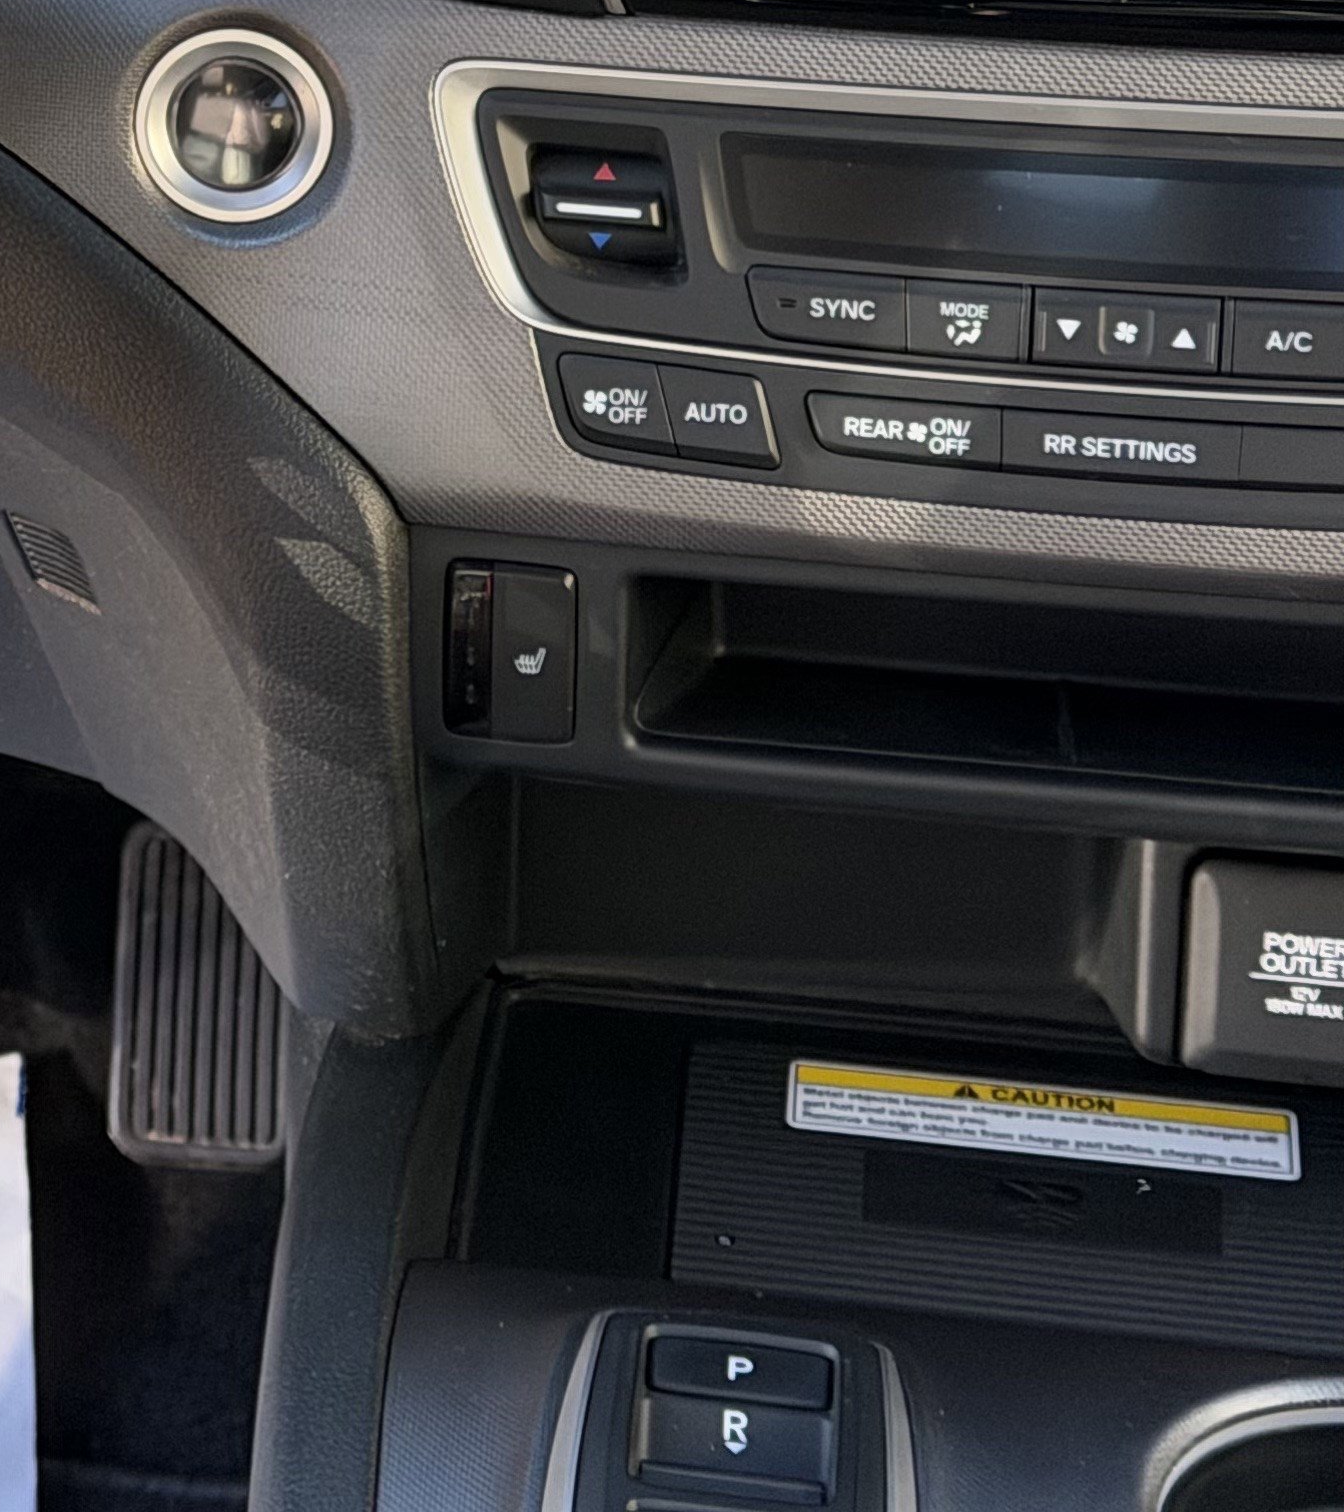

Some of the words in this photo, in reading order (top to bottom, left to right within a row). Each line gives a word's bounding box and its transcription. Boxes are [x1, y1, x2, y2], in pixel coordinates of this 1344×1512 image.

[809, 297, 876, 322] SYNC
[939, 301, 990, 321] MODE
[1264, 329, 1314, 353] A/C
[608, 387, 648, 406] ON/
[608, 405, 648, 425] OFF
[684, 401, 748, 425] AUTO
[843, 416, 904, 441] REAR
[929, 416, 972, 437] ON/
[928, 436, 972, 457] OFF
[1043, 433, 1077, 456] RR
[1080, 436, 1198, 465] SETTINGS
[991, 1087, 1116, 1114] CAUTION
[726, 1355, 754, 1382] P
[722, 1409, 749, 1443] R
